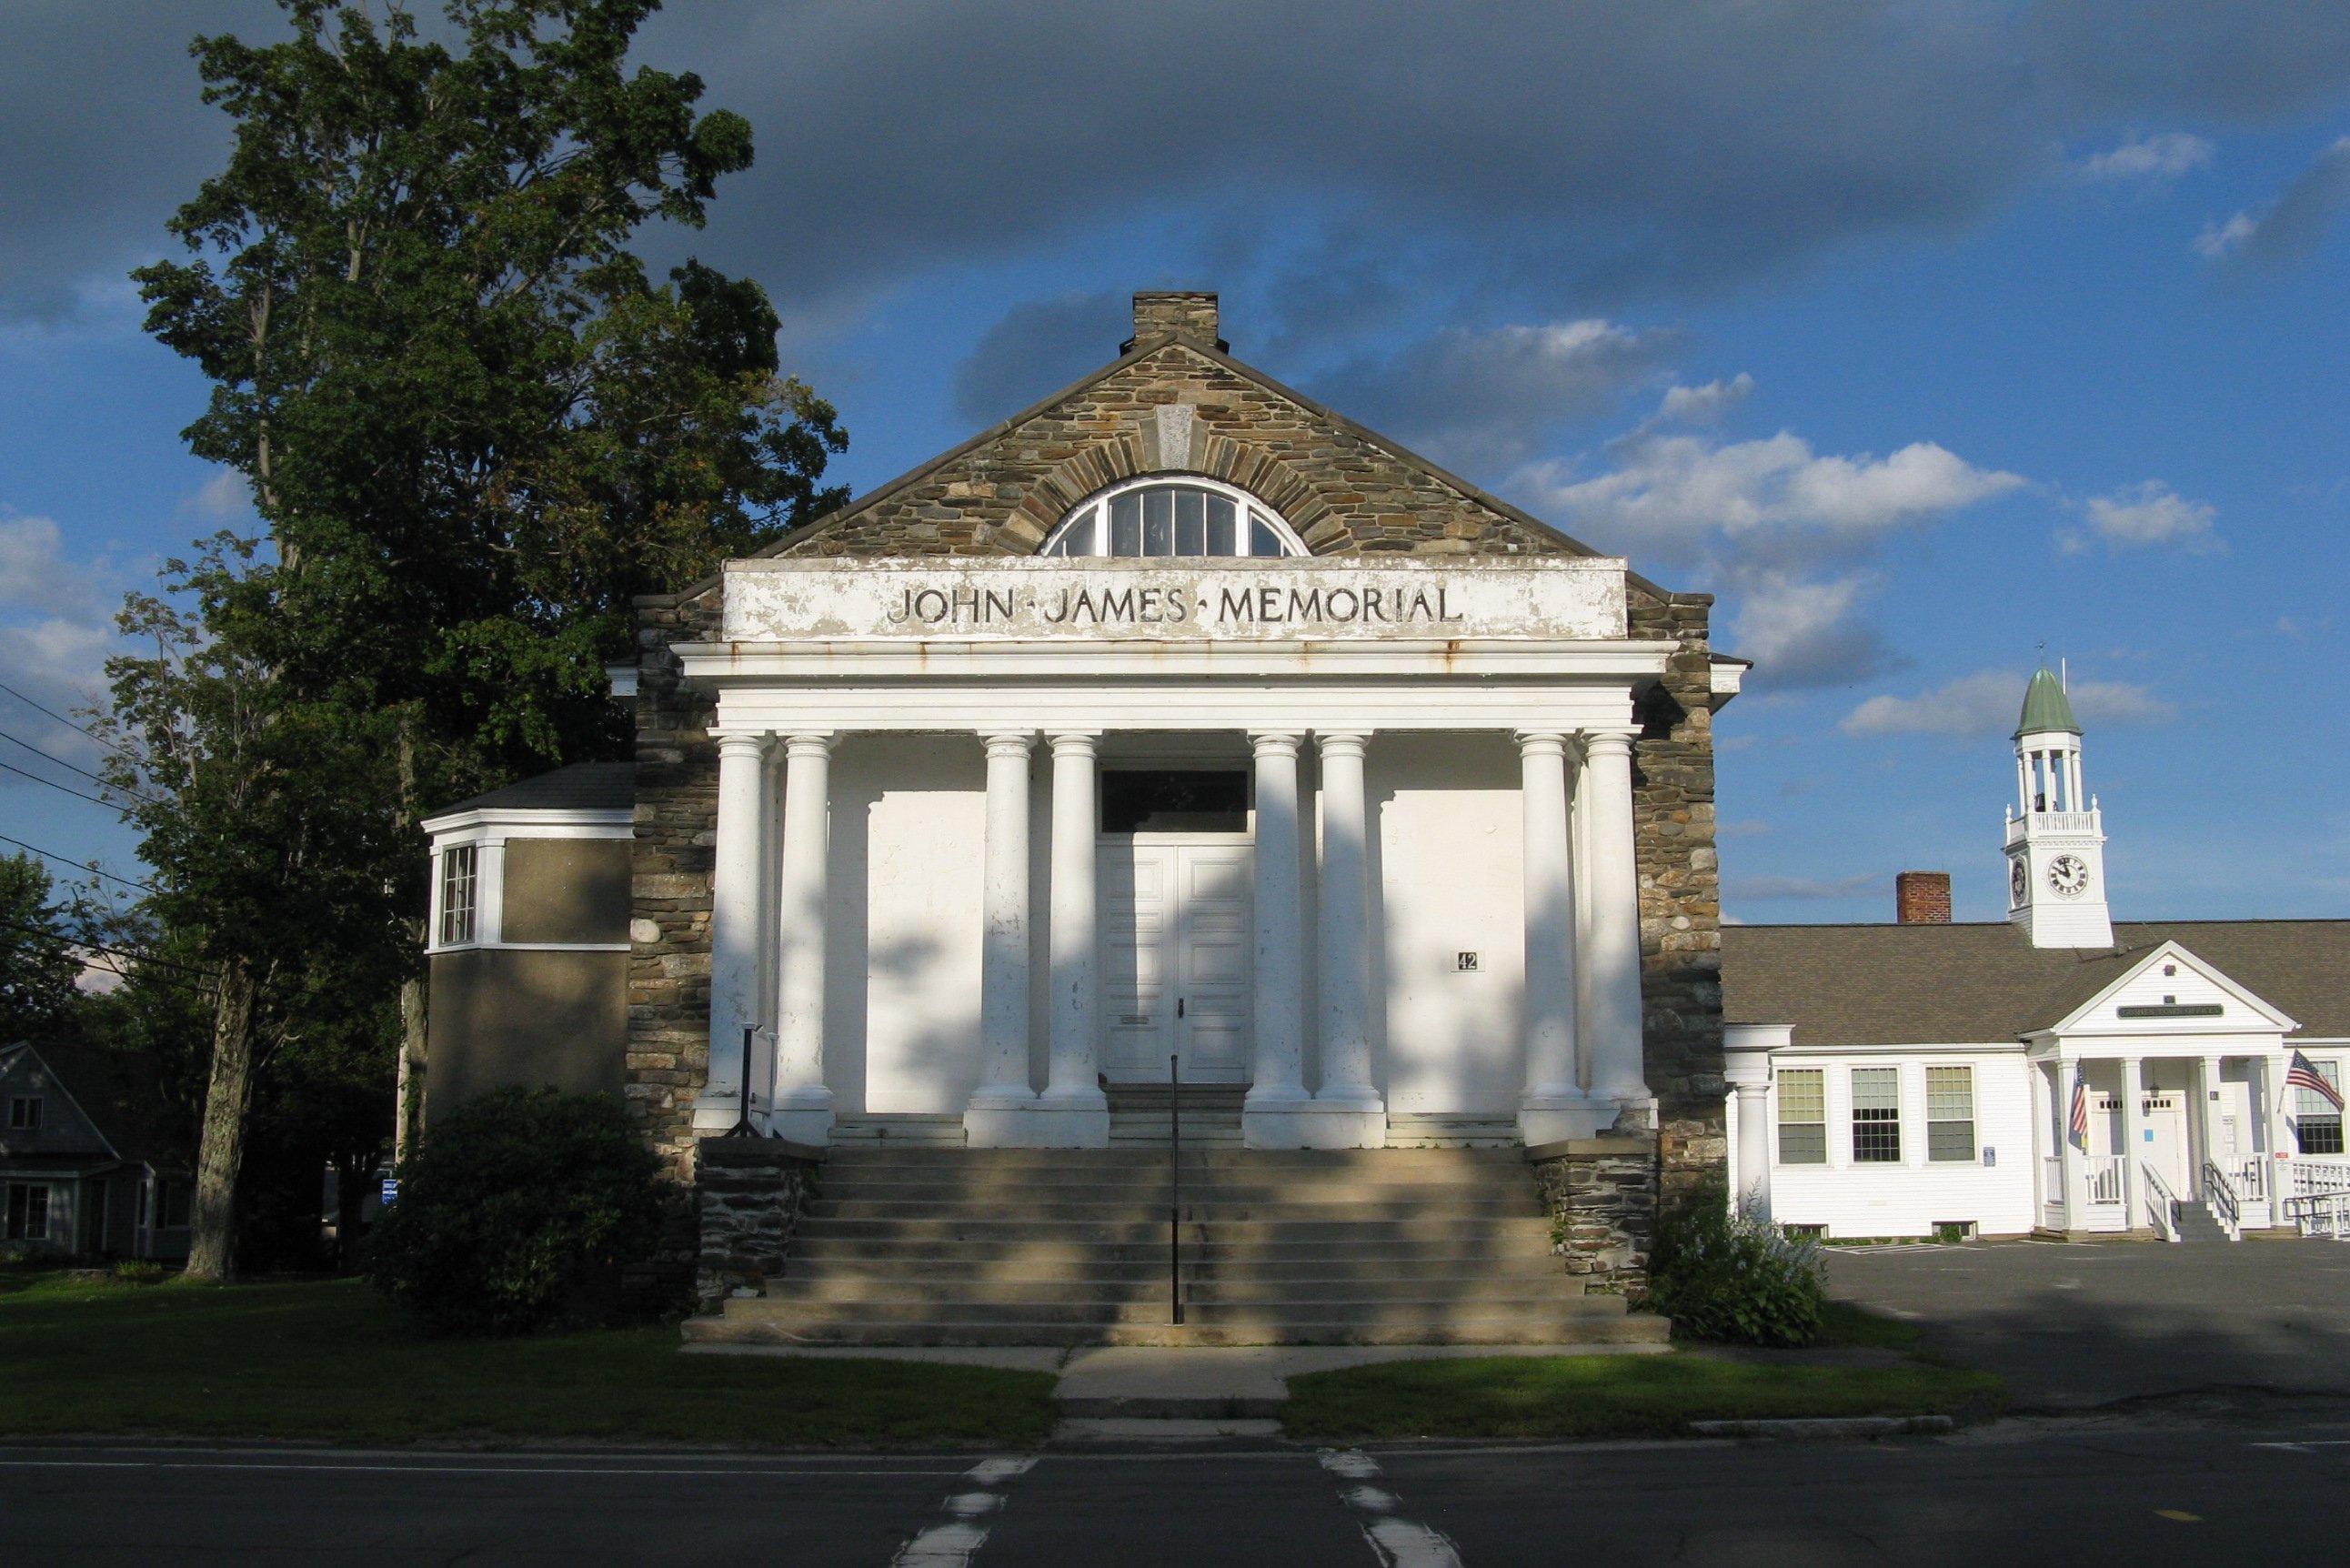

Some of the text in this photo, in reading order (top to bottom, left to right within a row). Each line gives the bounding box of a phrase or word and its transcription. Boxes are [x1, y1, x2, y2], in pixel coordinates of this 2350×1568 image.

[887, 588, 1463, 624] JOHN JAMES MEMORIAL
[1459, 953, 1477, 970] 42
